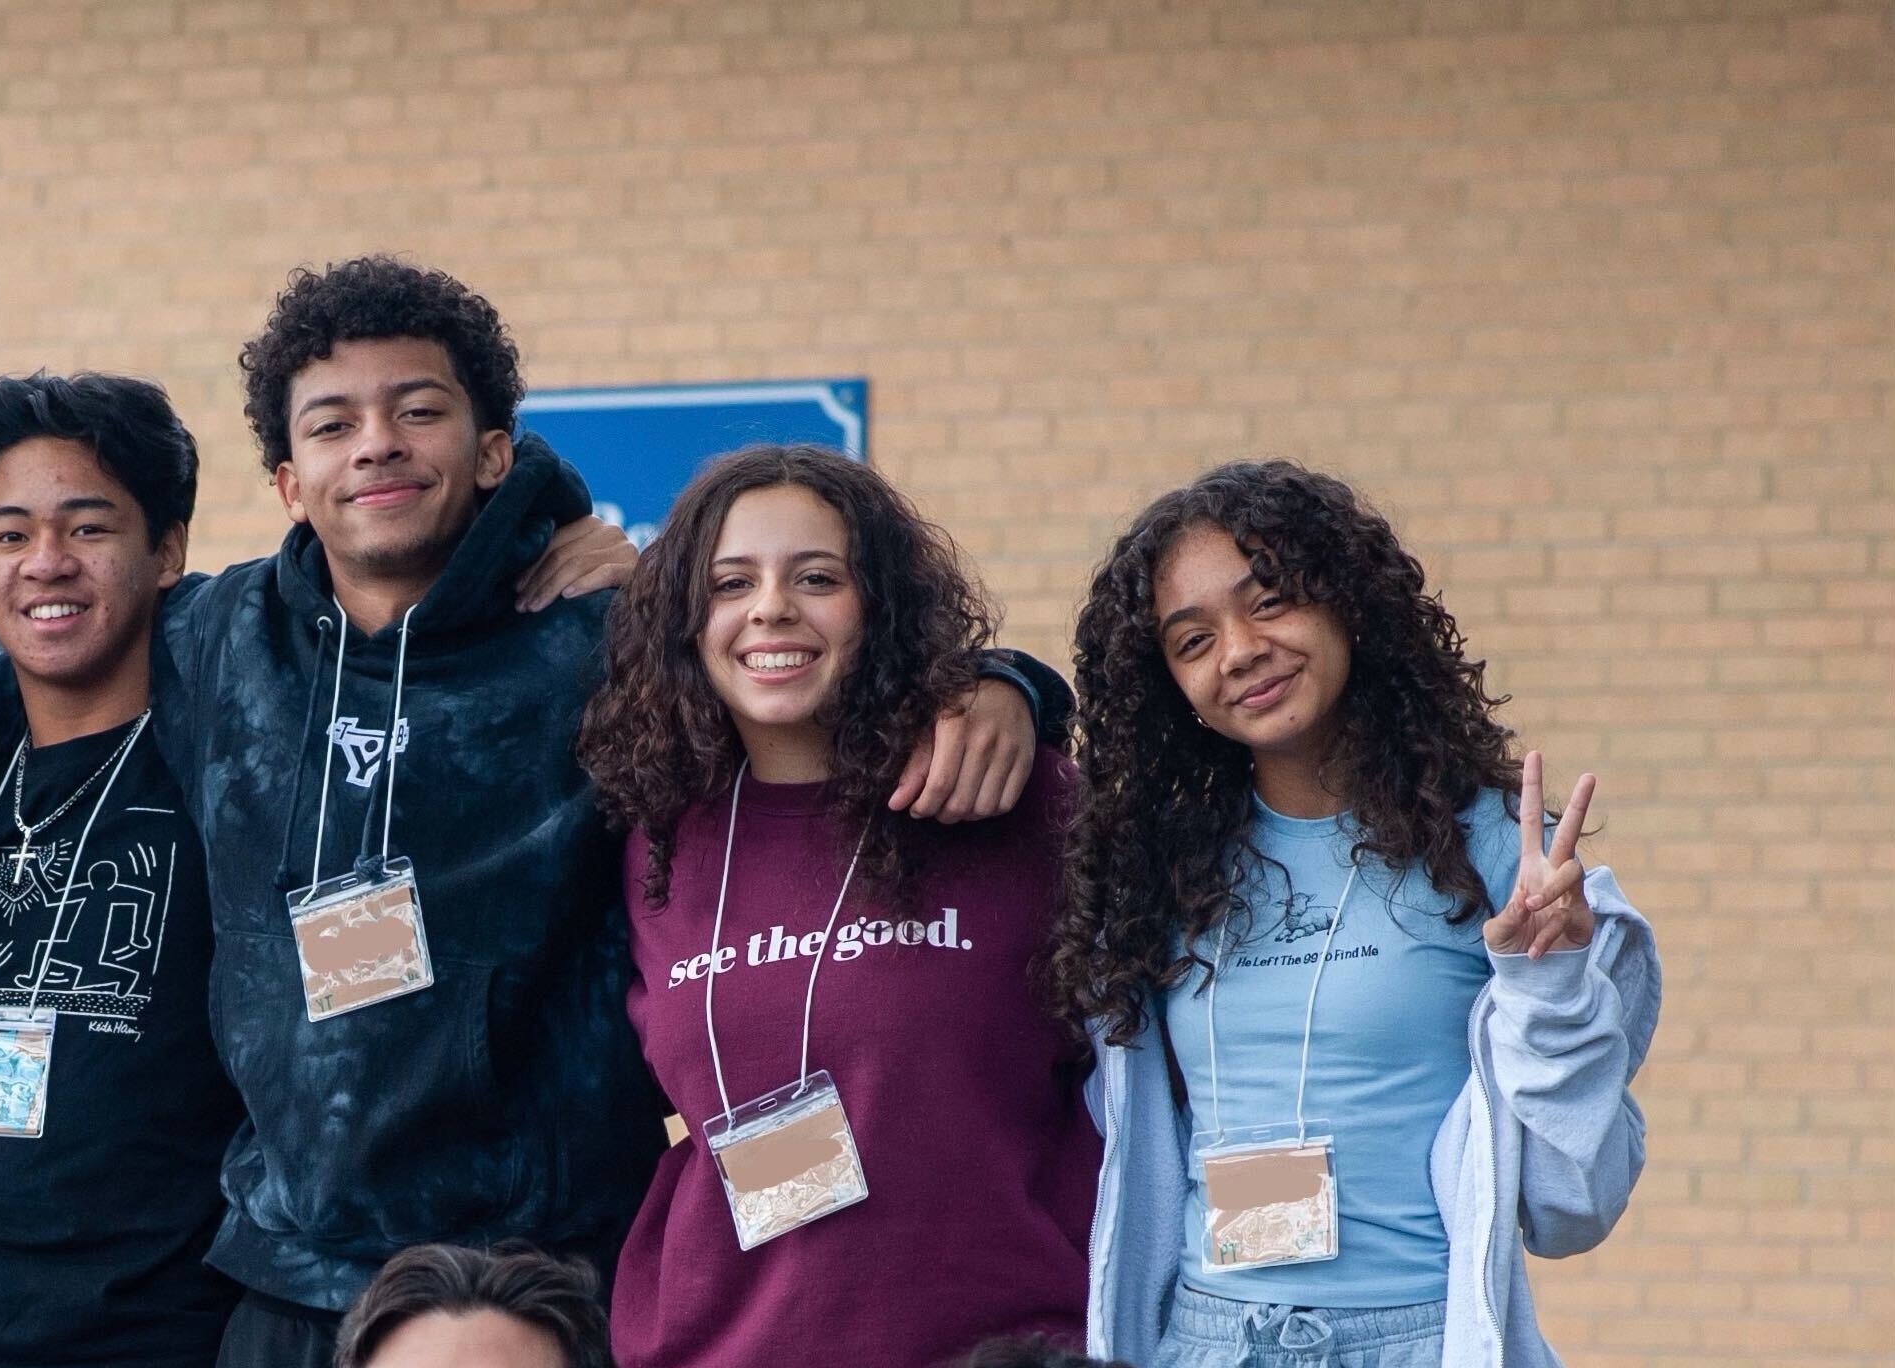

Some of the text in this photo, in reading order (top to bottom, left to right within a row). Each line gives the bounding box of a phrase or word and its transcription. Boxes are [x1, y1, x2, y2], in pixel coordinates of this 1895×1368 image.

[668, 908, 973, 989] see the good.
[1236, 957, 1251, 967] He
[1281, 955, 1301, 966] The
[1303, 953, 1318, 964] 99
[1334, 948, 1359, 961] Find
[1361, 944, 1379, 957] Me
